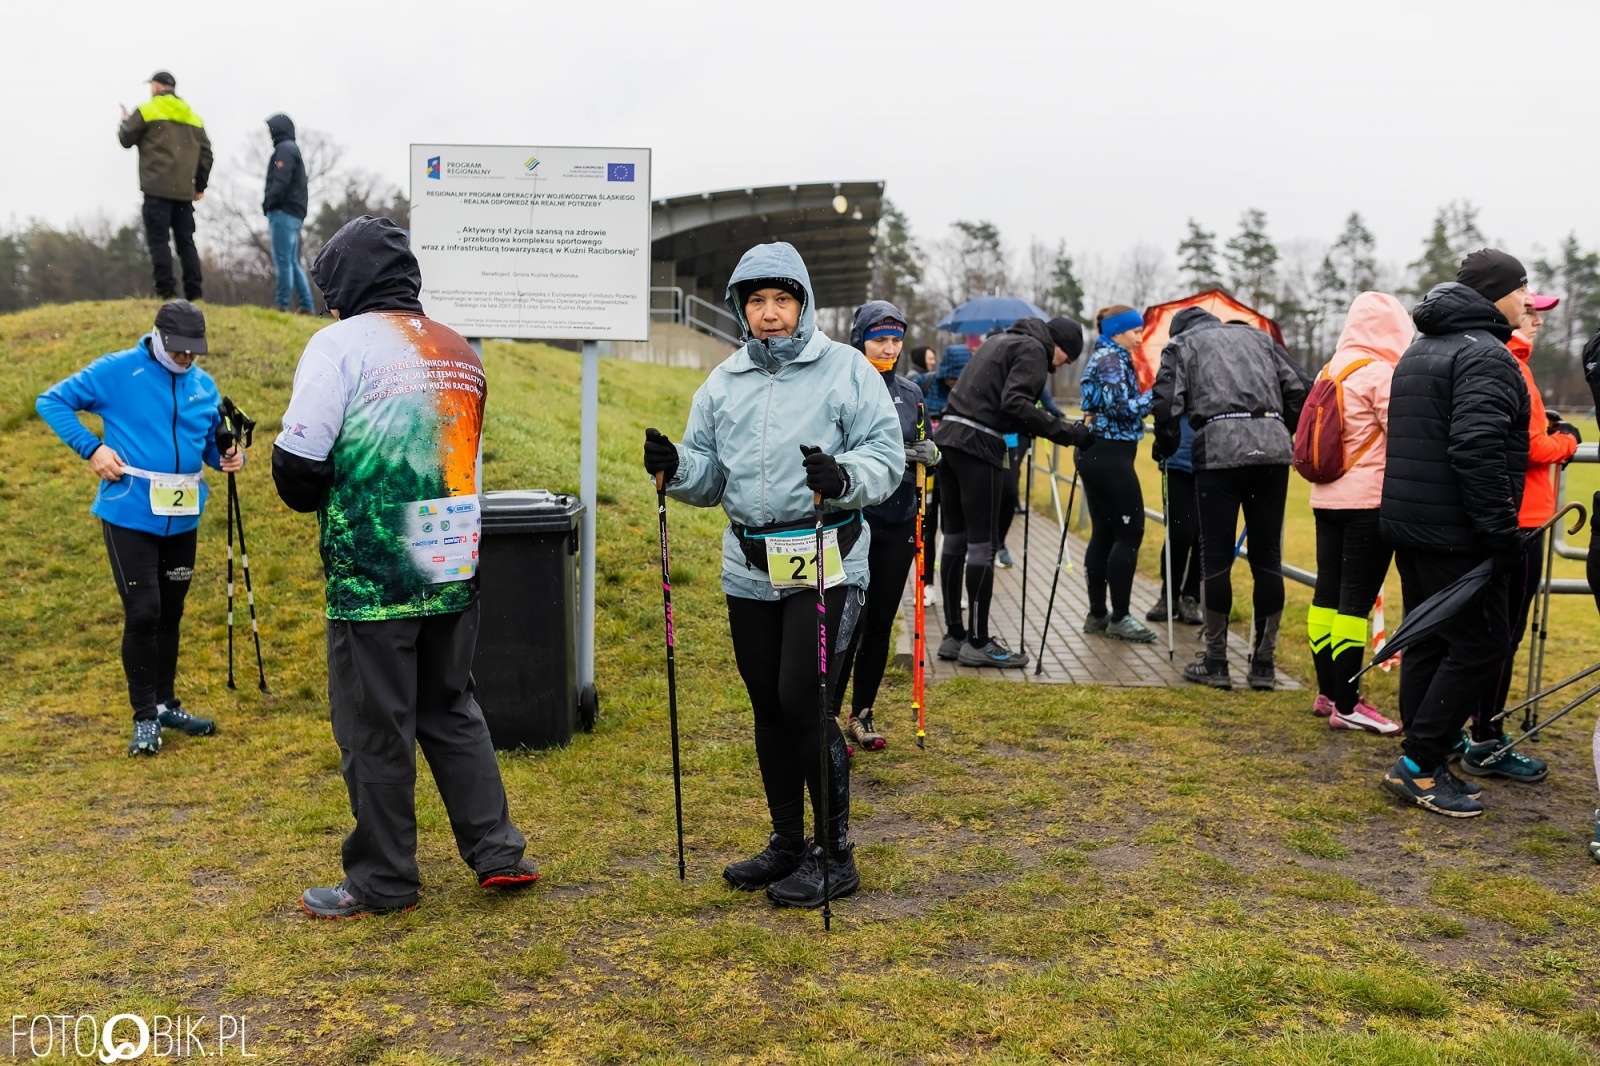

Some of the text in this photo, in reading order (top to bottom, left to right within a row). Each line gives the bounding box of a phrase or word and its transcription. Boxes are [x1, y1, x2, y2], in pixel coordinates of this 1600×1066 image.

[463, 226, 495, 235] Aktywny
[447, 244, 499, 253] infrastrukturą
[361, 371, 369, 380] W
[371, 361, 410, 377] HOŁDZIE
[412, 359, 450, 368] LEŚNIKOM
[373, 373, 409, 389] KTÓRZY
[364, 394, 371, 404] Z
[372, 384, 418, 400] POŻAREM
[429, 380, 452, 389] KUŹNI
[173, 490, 184, 506] 2
[666, 602, 674, 647] FIZAN
[819, 624, 827, 674] FIZAN
